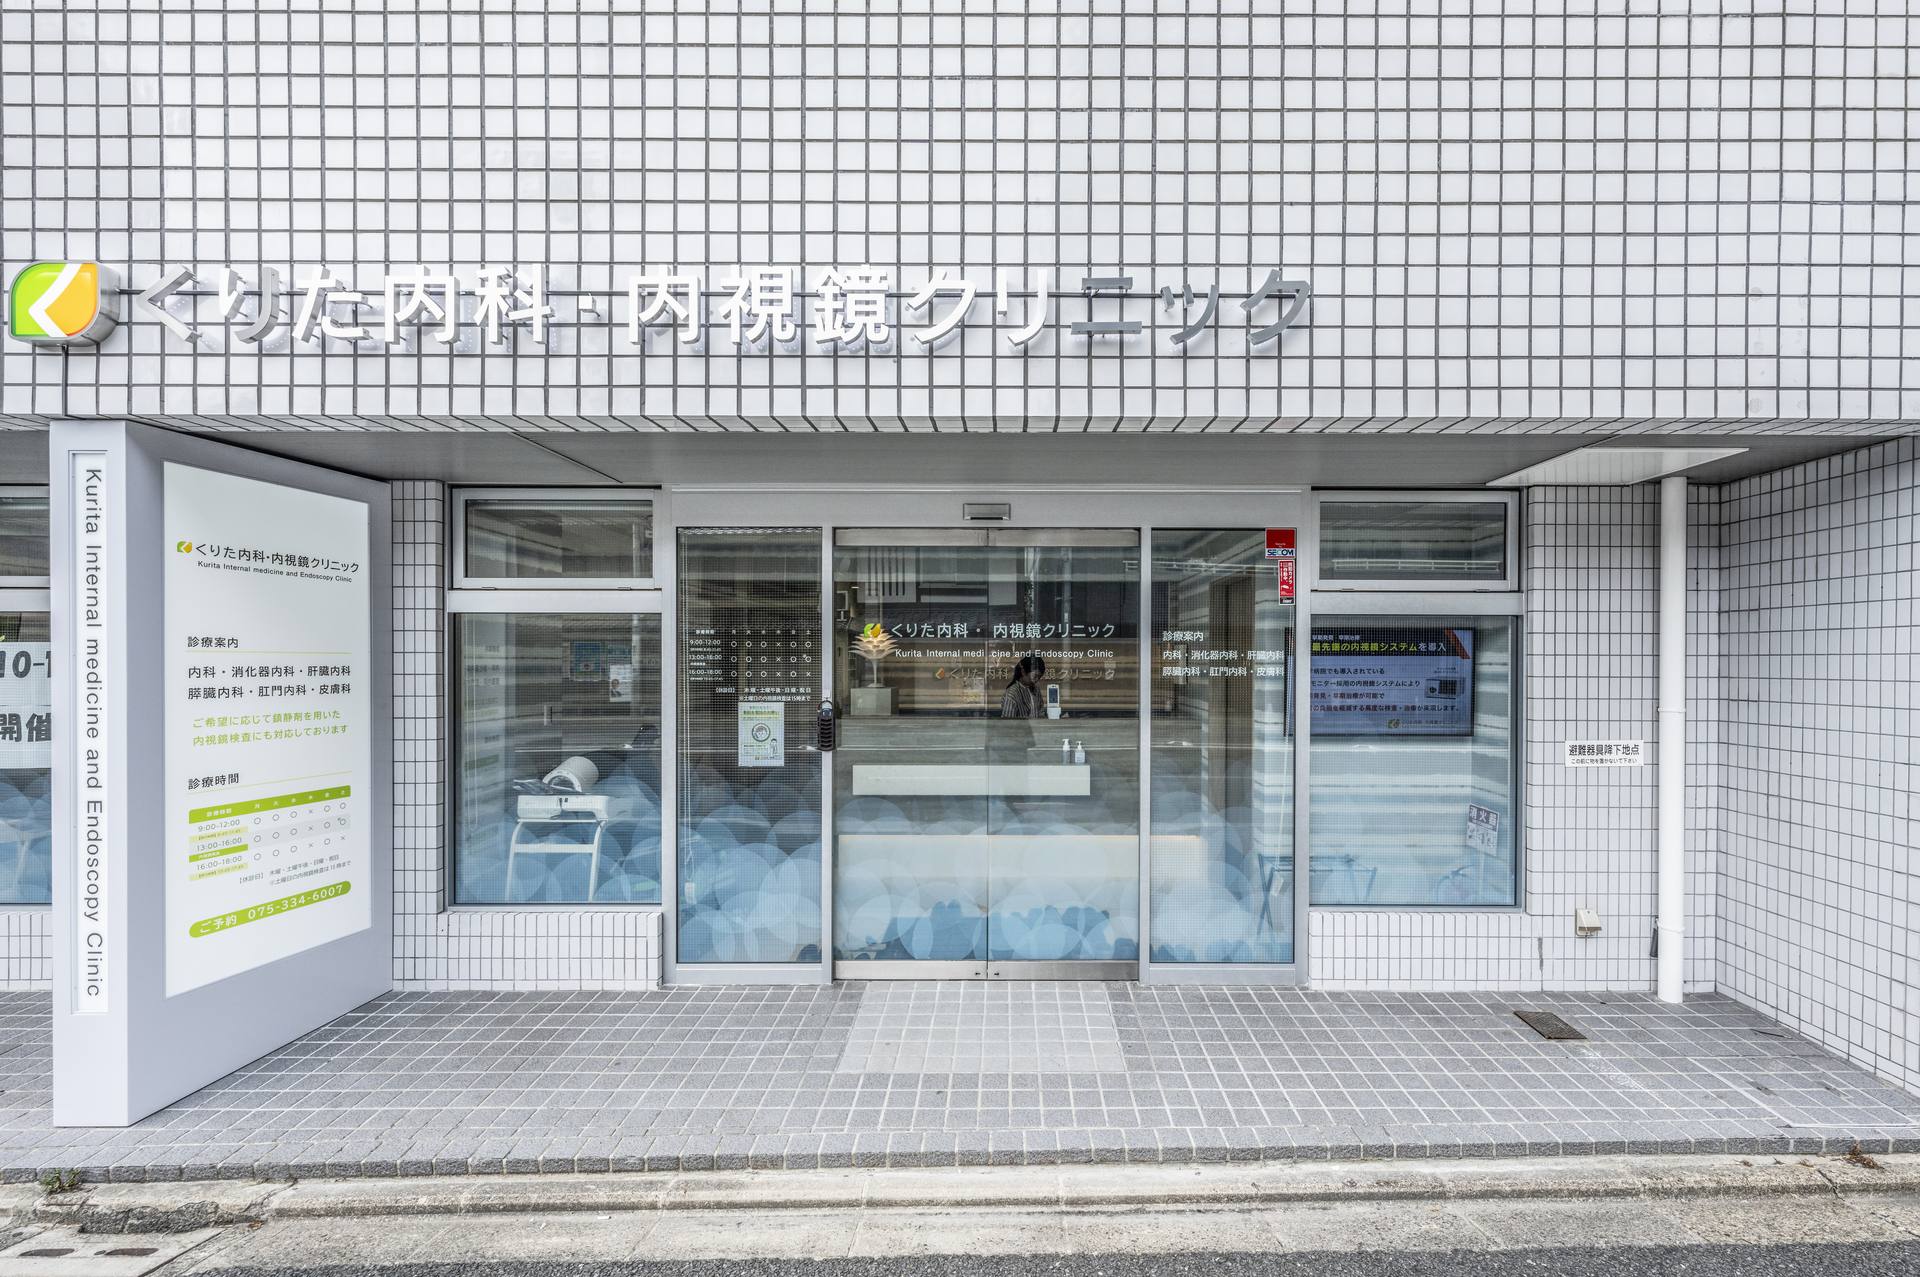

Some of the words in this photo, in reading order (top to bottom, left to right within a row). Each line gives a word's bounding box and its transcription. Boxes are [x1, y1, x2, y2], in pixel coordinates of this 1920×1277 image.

[137, 263, 1312, 347] くりた内科・内視鏡クリニック
[85, 469, 102, 534] Kurita
[196, 543, 360, 573] くりた内科・内視鏡クリニック
[197, 560, 221, 570] Kurita
[223, 563, 251, 572] Internal
[253, 567, 284, 576] medicine
[286, 569, 298, 577] and
[300, 572, 333, 582] Endoscopy
[335, 575, 352, 583] Clinic
[86, 545, 102, 627] Internal
[187, 636, 239, 649] 診療案内
[1162, 631, 1204, 642] 診療案内
[895, 648, 922, 658] Kurita
[926, 648, 960, 658] Internal
[1015, 648, 1031, 658] and
[1035, 649, 1084, 660] Endoscopy
[1087, 648, 1114, 658] Clinic
[188, 665, 351, 679] 内科・消化器内科・肝臓内科
[86, 639, 102, 739] medicine
[187, 683, 351, 700] 膵臓内科・肛門内科・皮膚科
[1568, 744, 1640, 756] 避難器具降下地点
[86, 749, 102, 788] and
[187, 773, 239, 790] 診療時間
[198, 818, 240, 832] 9:00-12:00
[197, 837, 242, 851] 13:00-16:00
[84, 800, 103, 921] Endoscopy
[197, 855, 242, 870] 16:00-18:00
[199, 914, 237, 933] ご予約
[247, 885, 344, 919] 075-334-6007
[86, 932, 103, 997] Clinic
